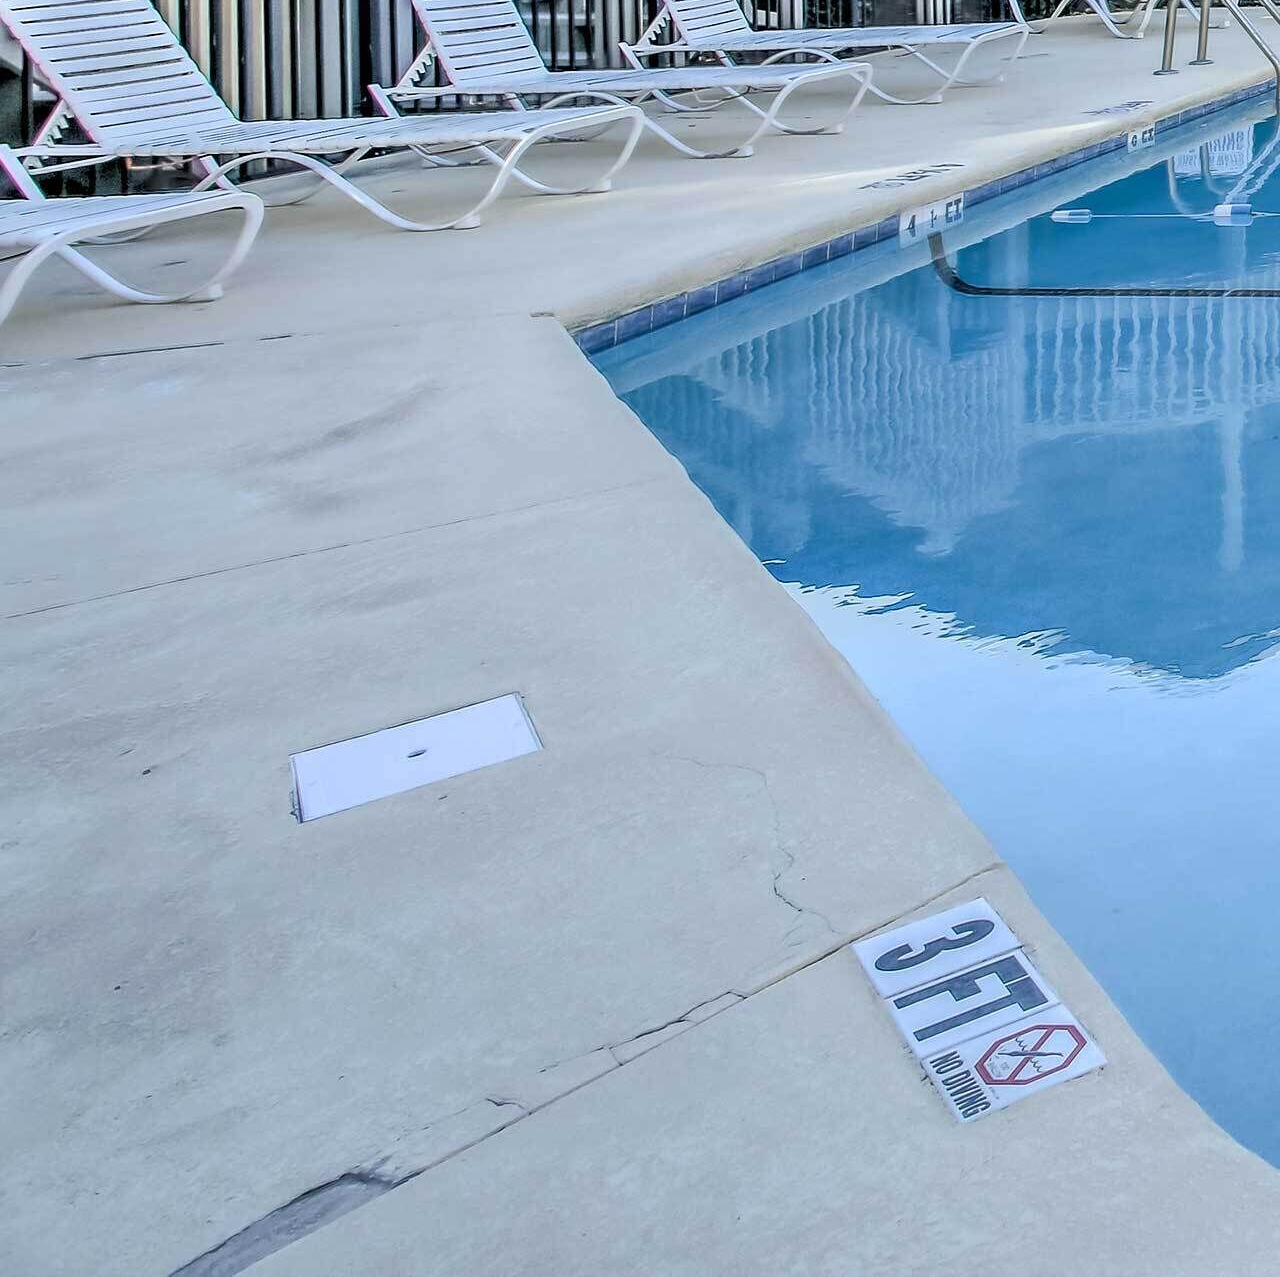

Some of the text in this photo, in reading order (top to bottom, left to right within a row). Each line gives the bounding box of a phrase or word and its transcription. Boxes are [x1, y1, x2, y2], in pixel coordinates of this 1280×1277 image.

[874, 918, 995, 972] 3
[892, 954, 1050, 1043] FT
[929, 1050, 992, 1120] NO DIVING
